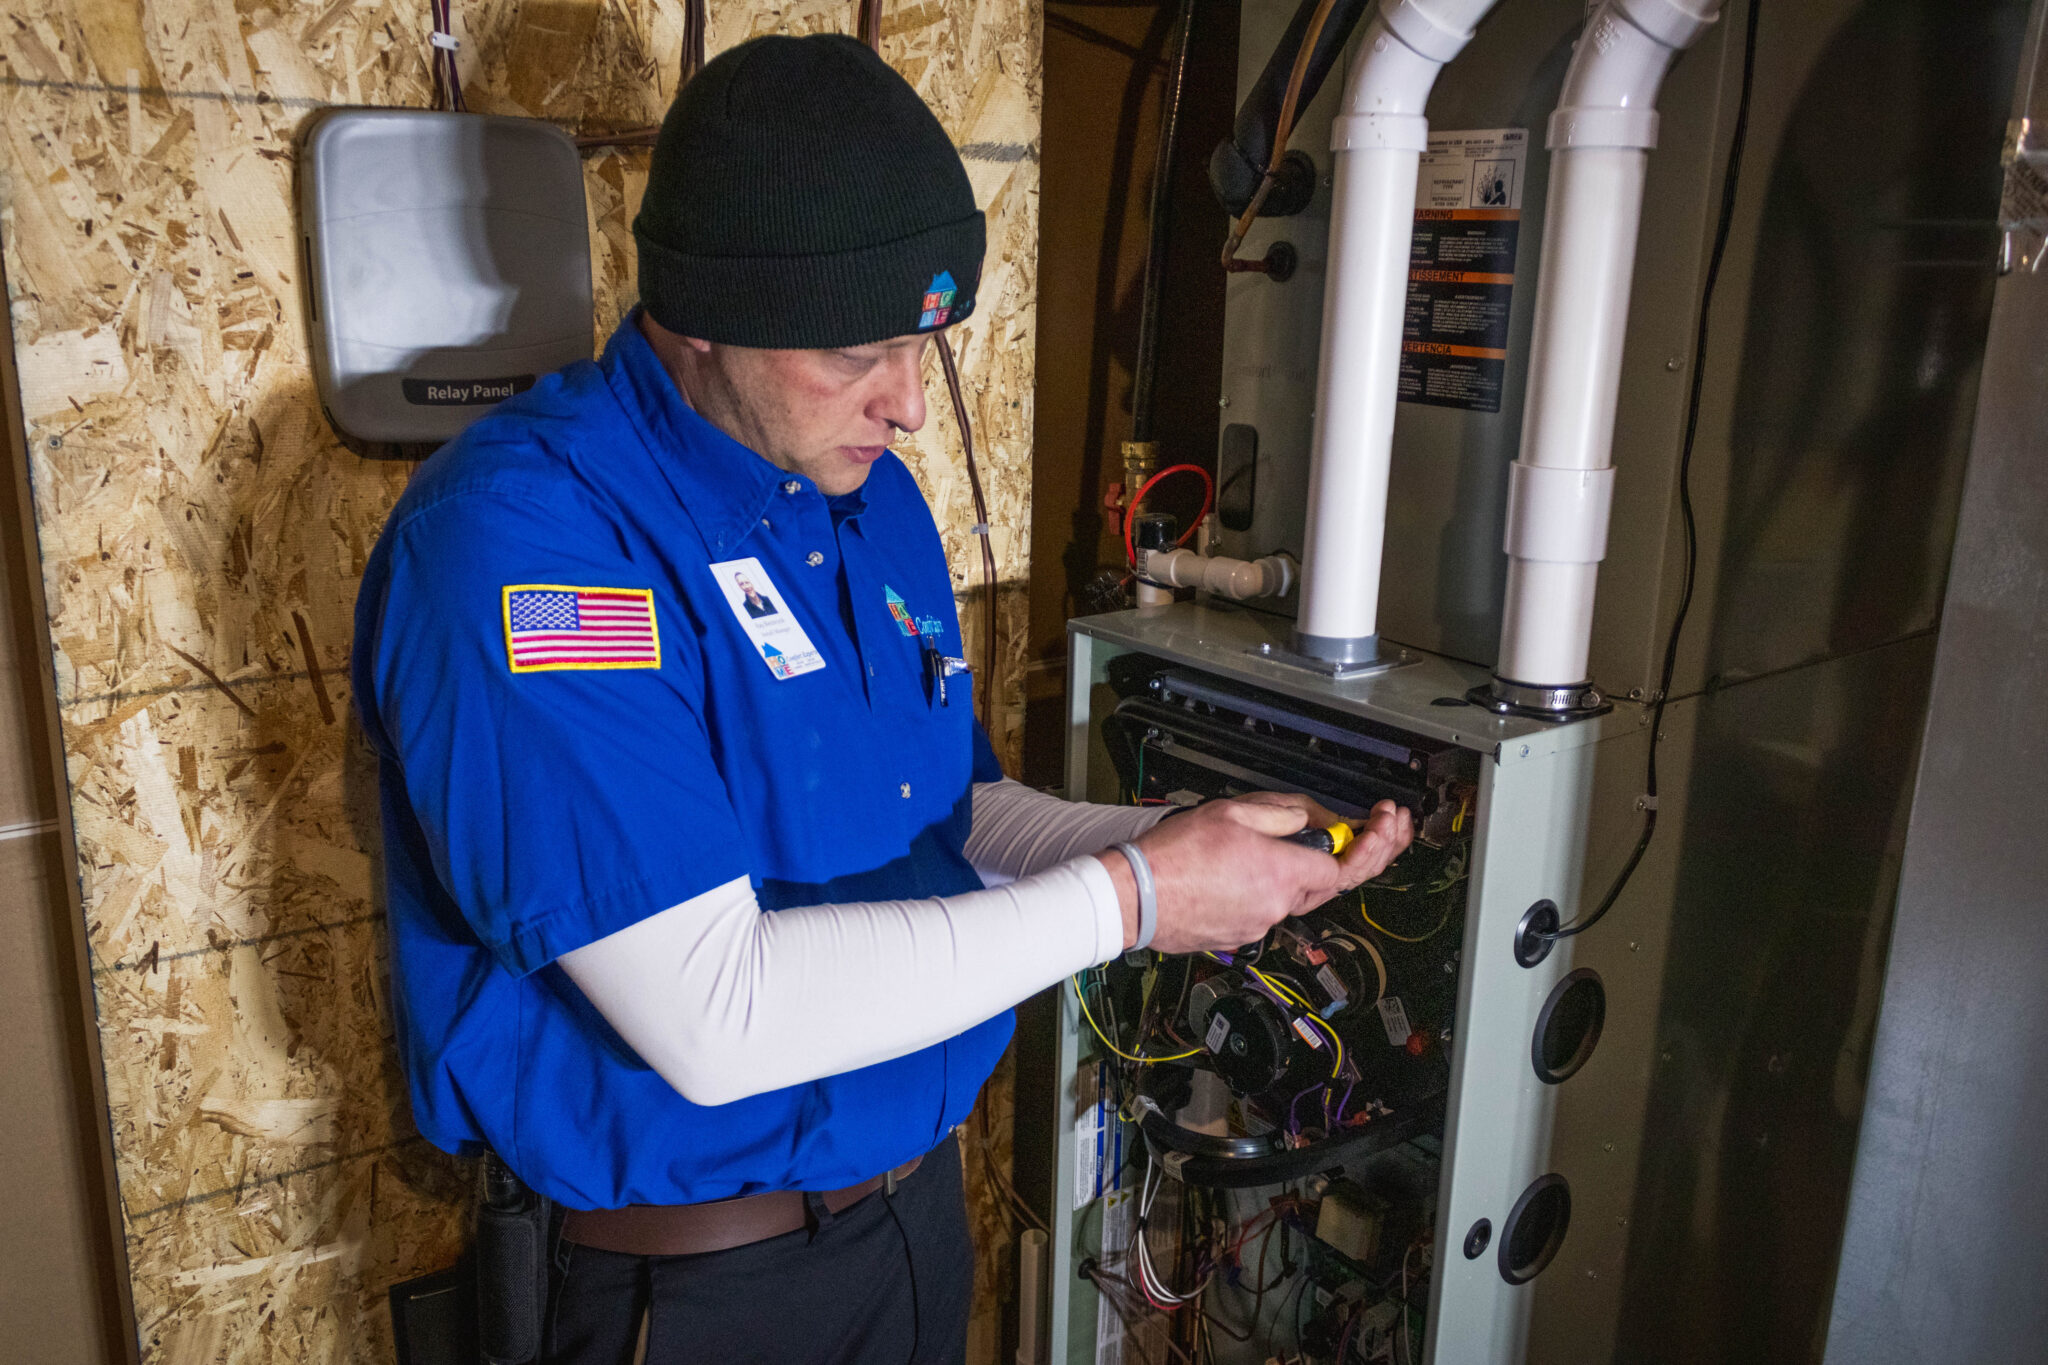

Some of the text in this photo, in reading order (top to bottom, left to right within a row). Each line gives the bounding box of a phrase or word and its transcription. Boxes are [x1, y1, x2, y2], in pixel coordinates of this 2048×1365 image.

[1408, 271, 1465, 281] RTISSEMENT
[1402, 342, 1451, 353] VERTENCIA
[427, 383, 514, 401] Relay Panel
